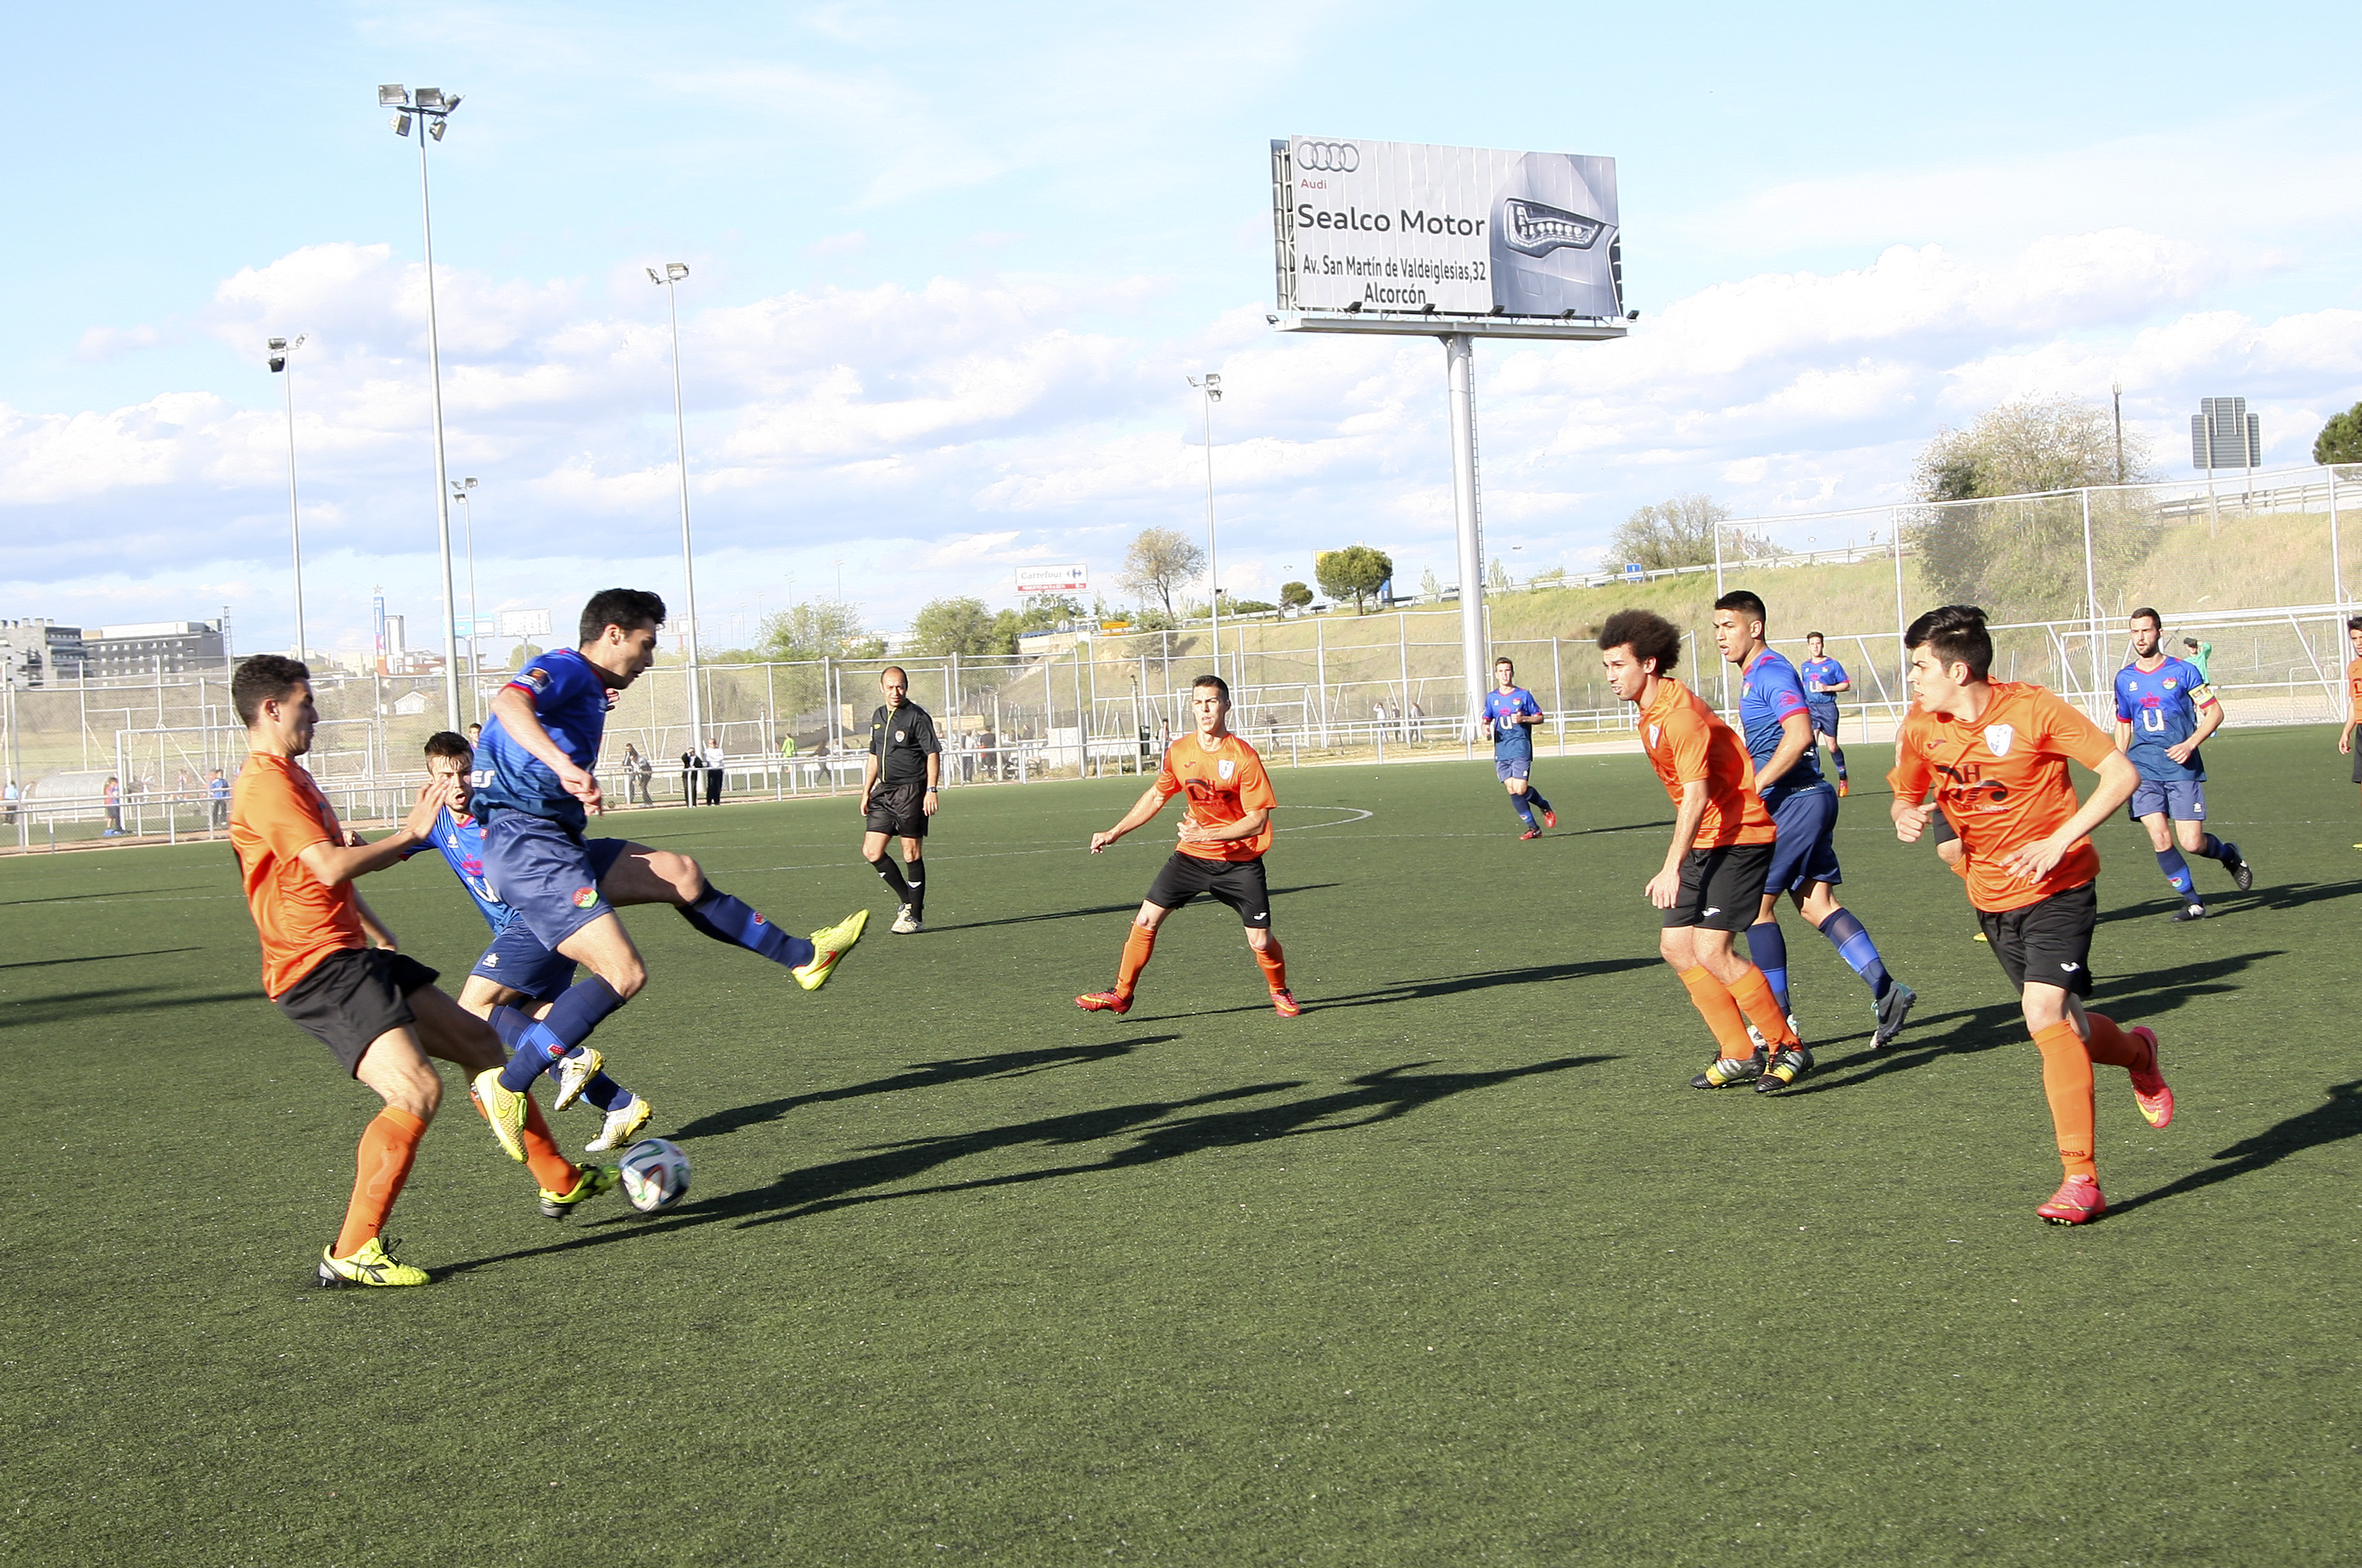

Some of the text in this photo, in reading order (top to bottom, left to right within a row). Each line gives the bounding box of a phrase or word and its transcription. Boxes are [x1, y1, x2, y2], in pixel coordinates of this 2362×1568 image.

[1301, 178, 1327, 189] Audi
[1297, 204, 1486, 236] Sealco Motor
[1303, 254, 1320, 274] Av.
[1323, 255, 1343, 275] San
[1346, 255, 1382, 277] Martín
[1385, 256, 1398, 277] de
[1364, 282, 1426, 305] Alcorcón
[1021, 570, 1061, 580] Carrefour
